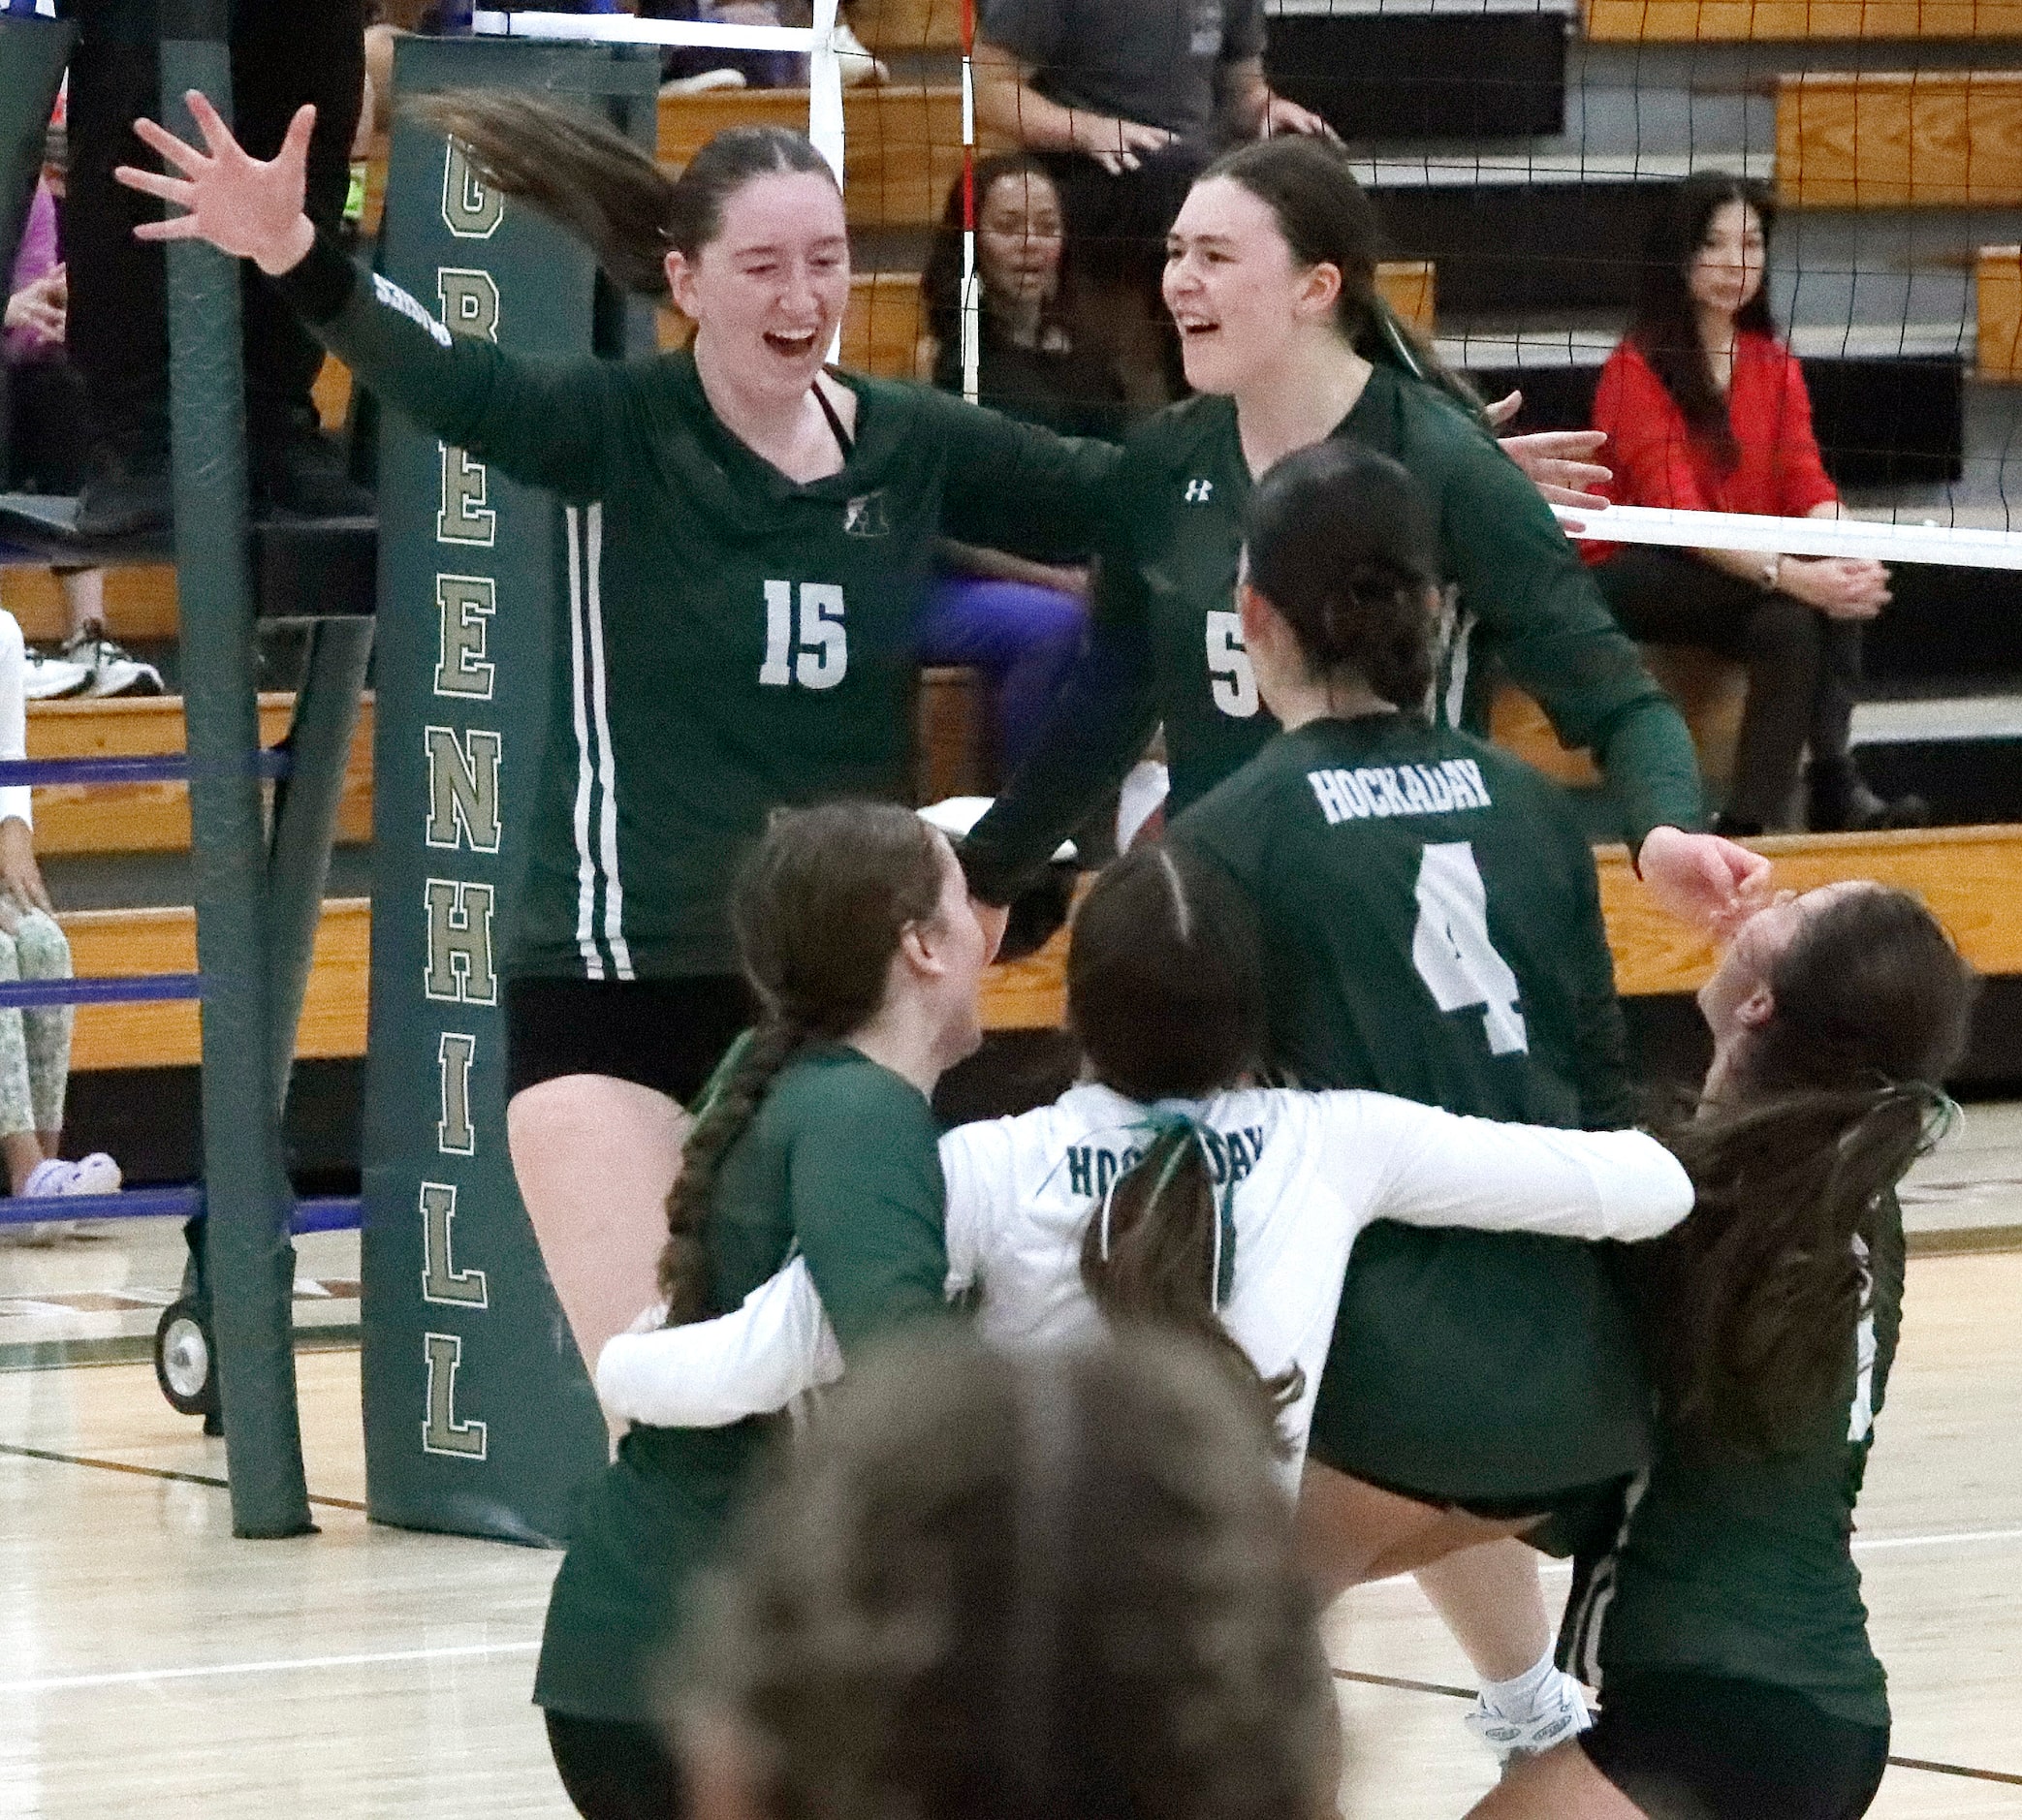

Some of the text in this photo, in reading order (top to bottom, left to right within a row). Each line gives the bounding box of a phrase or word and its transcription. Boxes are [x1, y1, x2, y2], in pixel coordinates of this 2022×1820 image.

[759, 580, 847, 689] 15
[1205, 610, 1259, 717] 5
[1308, 759, 1491, 825] HOCKADAY
[1412, 841, 1529, 1054] 4
